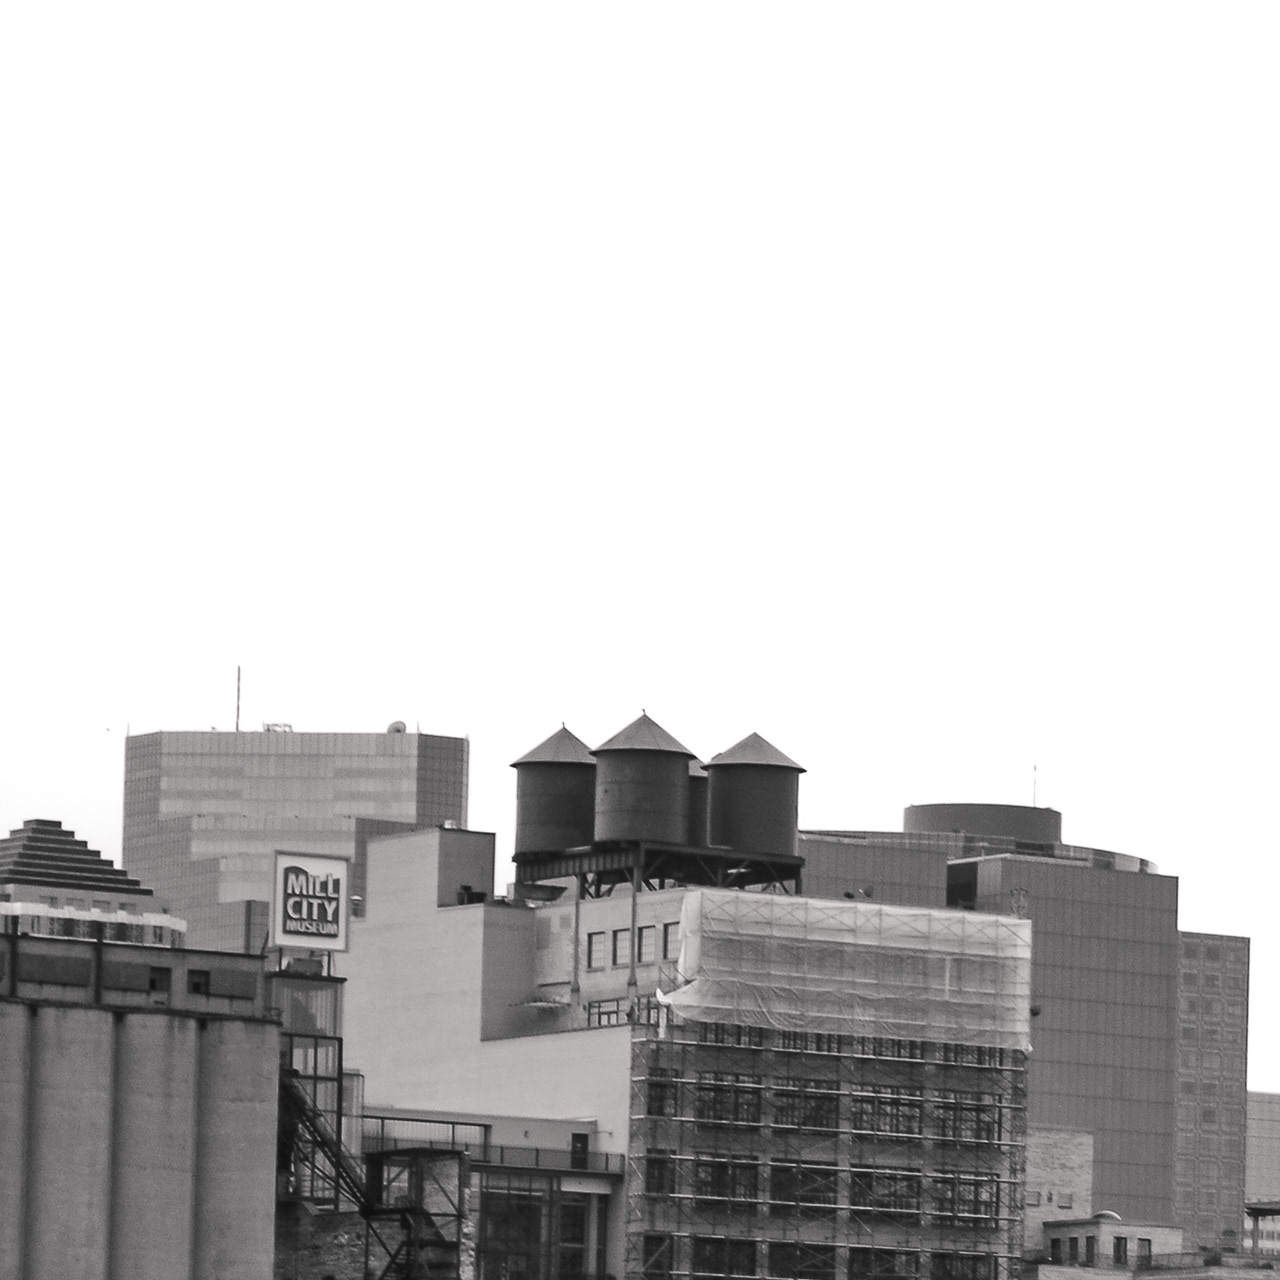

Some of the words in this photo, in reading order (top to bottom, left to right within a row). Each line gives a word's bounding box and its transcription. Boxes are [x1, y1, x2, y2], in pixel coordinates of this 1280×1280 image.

[286, 872, 338, 897] MILL
[286, 898, 338, 921] CITY
[286, 919, 338, 935] MUSEUM
